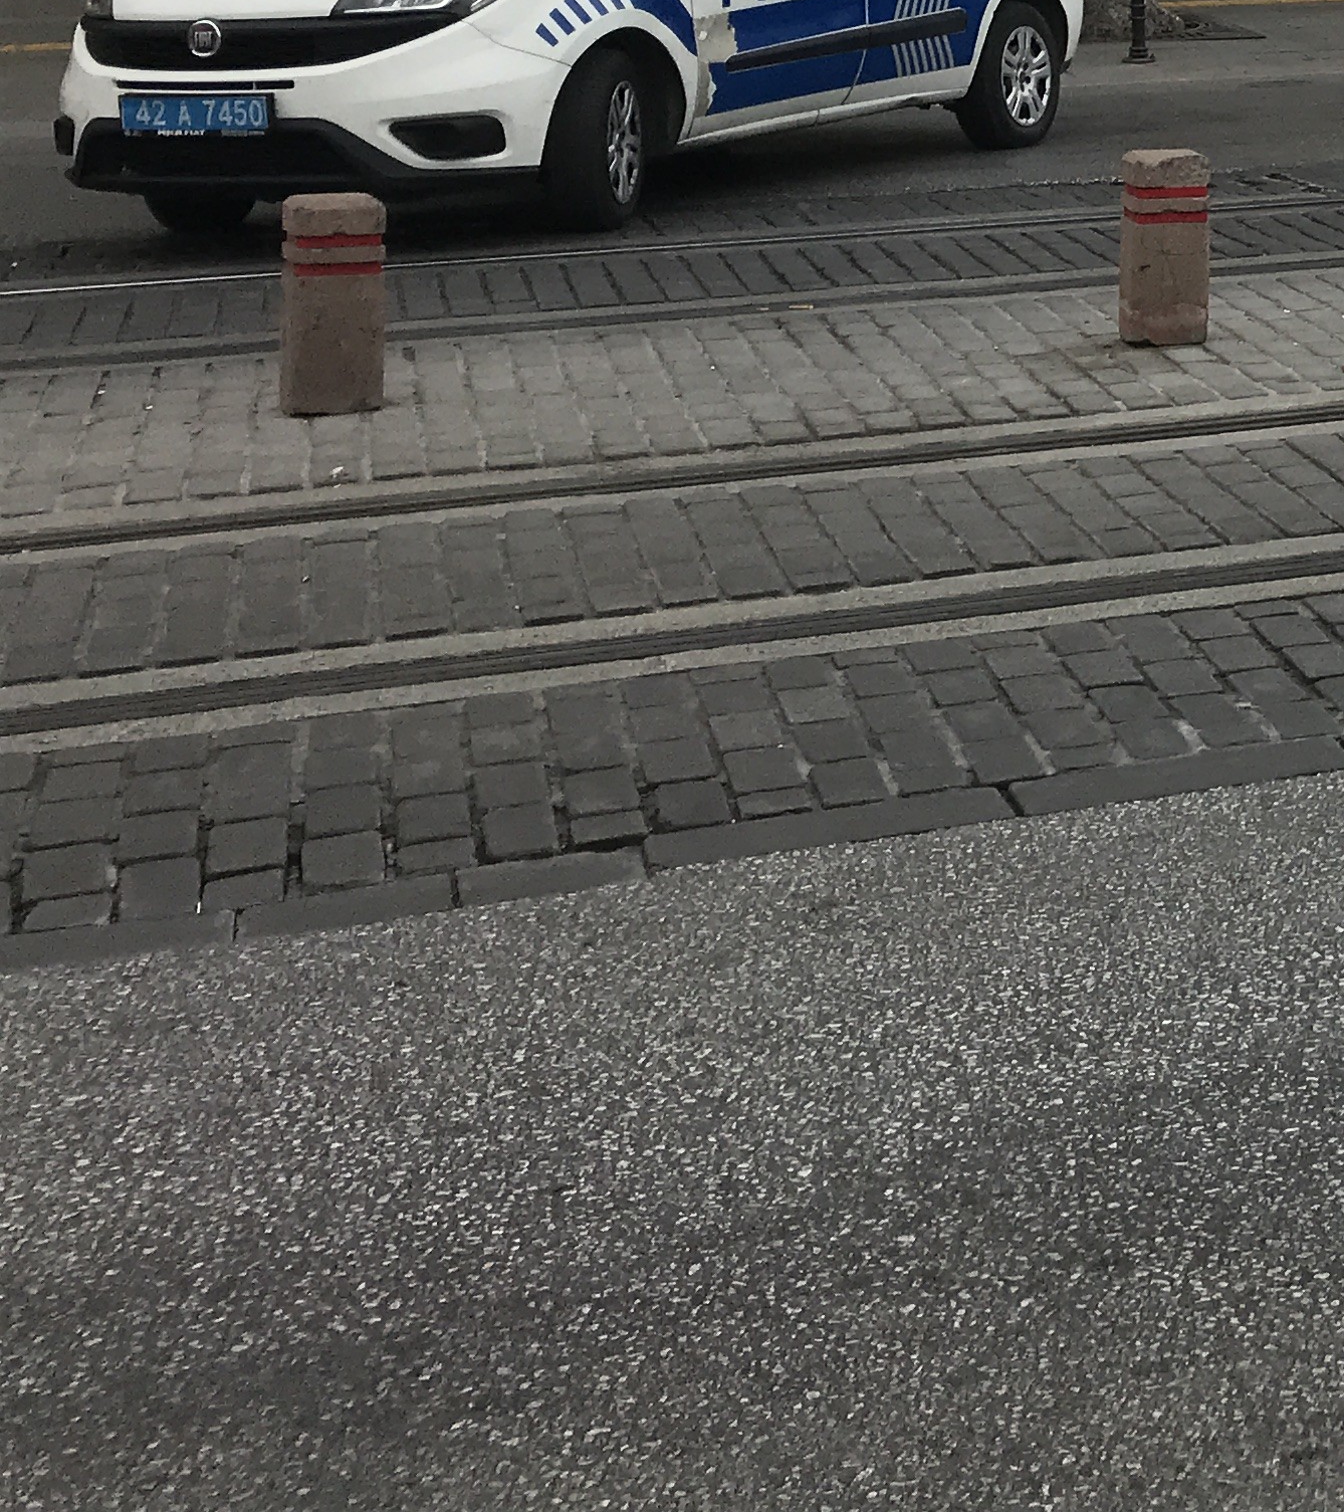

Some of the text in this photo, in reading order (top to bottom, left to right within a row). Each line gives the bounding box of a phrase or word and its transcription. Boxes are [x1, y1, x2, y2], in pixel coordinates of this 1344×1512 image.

[135, 100, 264, 126] 42 A 7450
